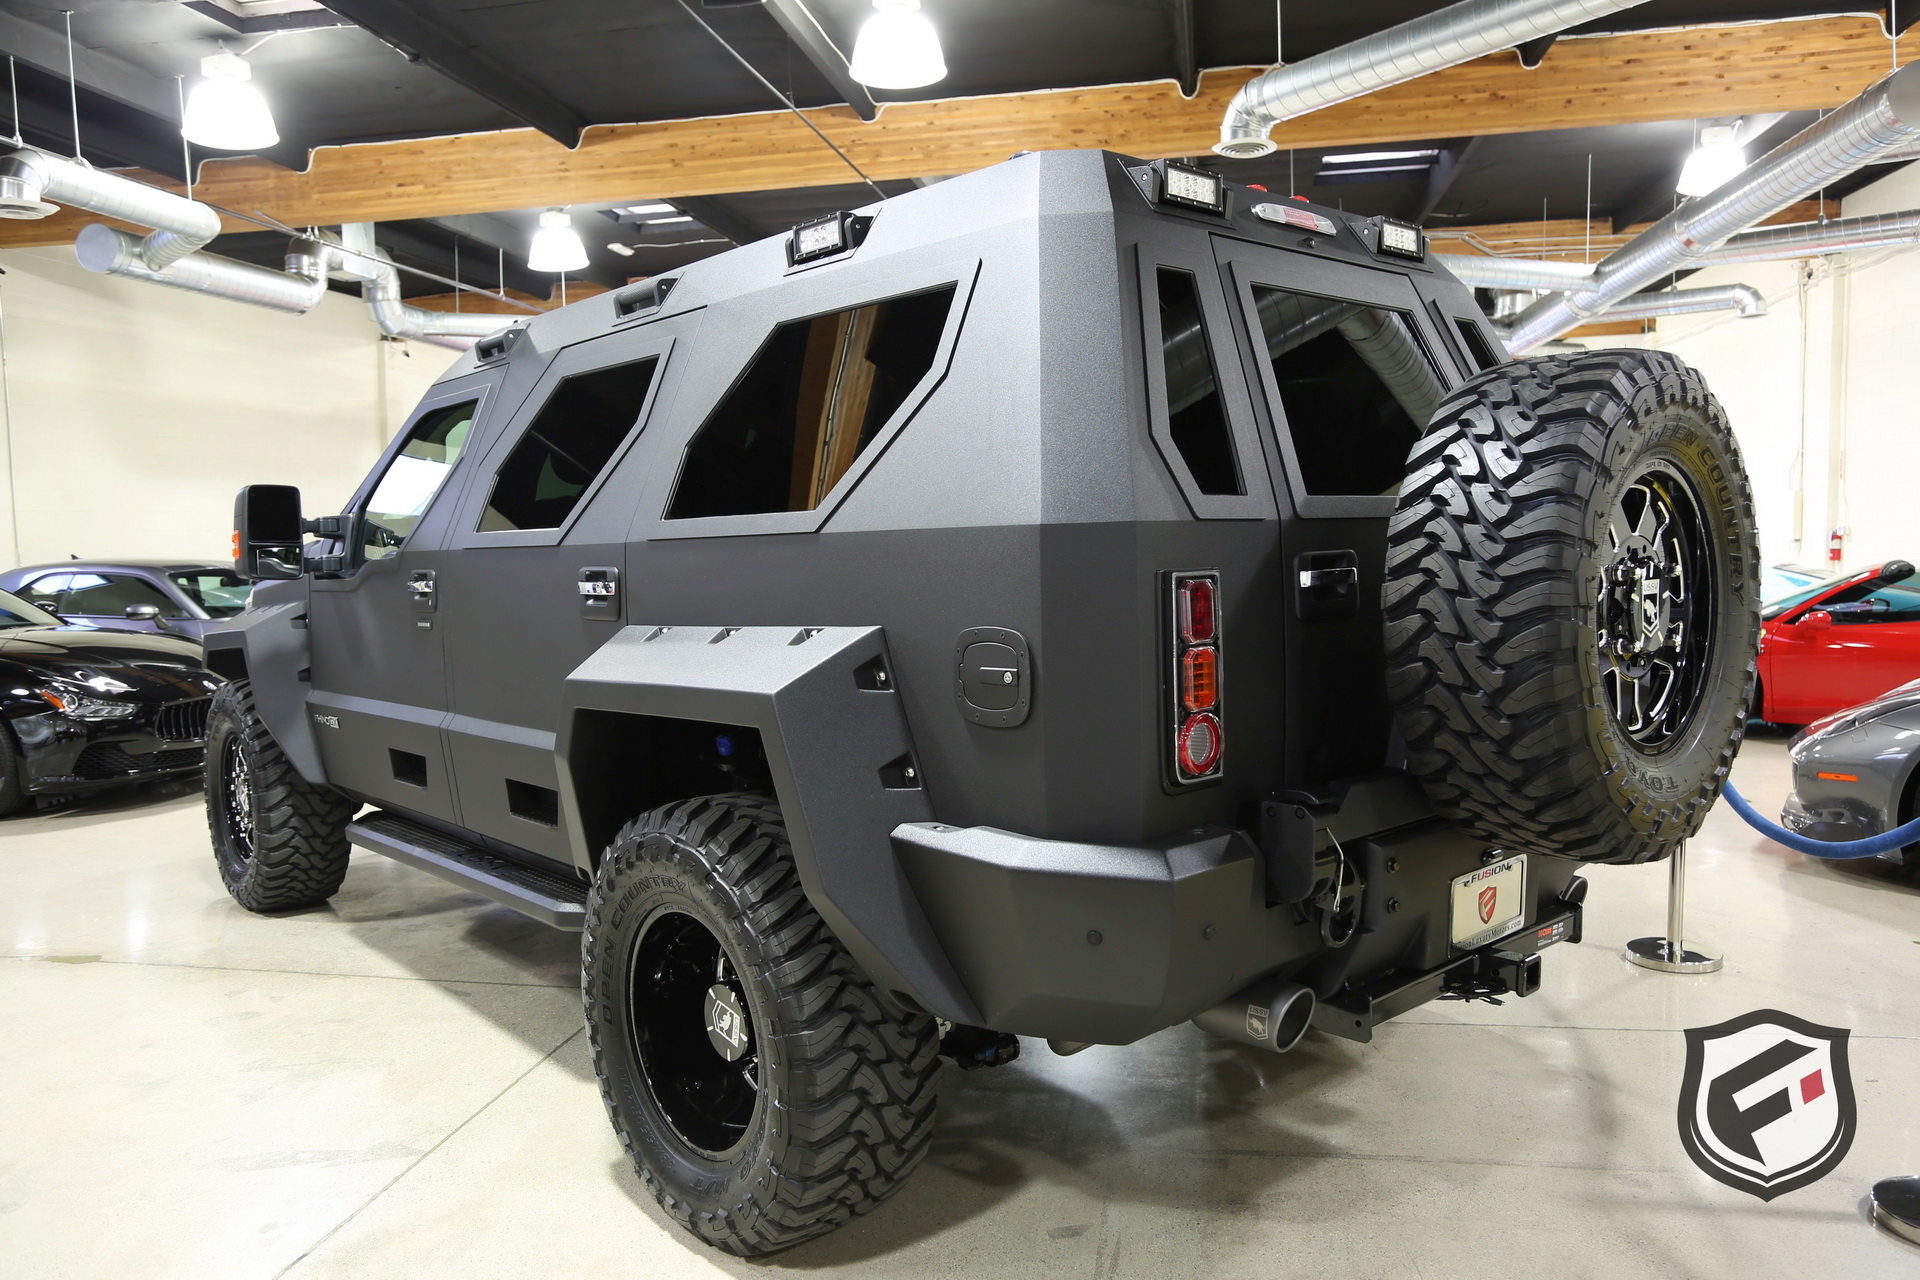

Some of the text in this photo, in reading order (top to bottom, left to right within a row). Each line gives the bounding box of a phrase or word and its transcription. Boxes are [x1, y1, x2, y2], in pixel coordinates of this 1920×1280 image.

[1647, 424, 1699, 449] OPEN
[1697, 444, 1744, 607] COUNTRY
[1625, 754, 1680, 793] TOYO
[1471, 863, 1511, 883] FUSION
[611, 875, 687, 930] COUNTRY
[602, 936, 616, 1025] OPEN
[1250, 1006, 1268, 1016] USSV
